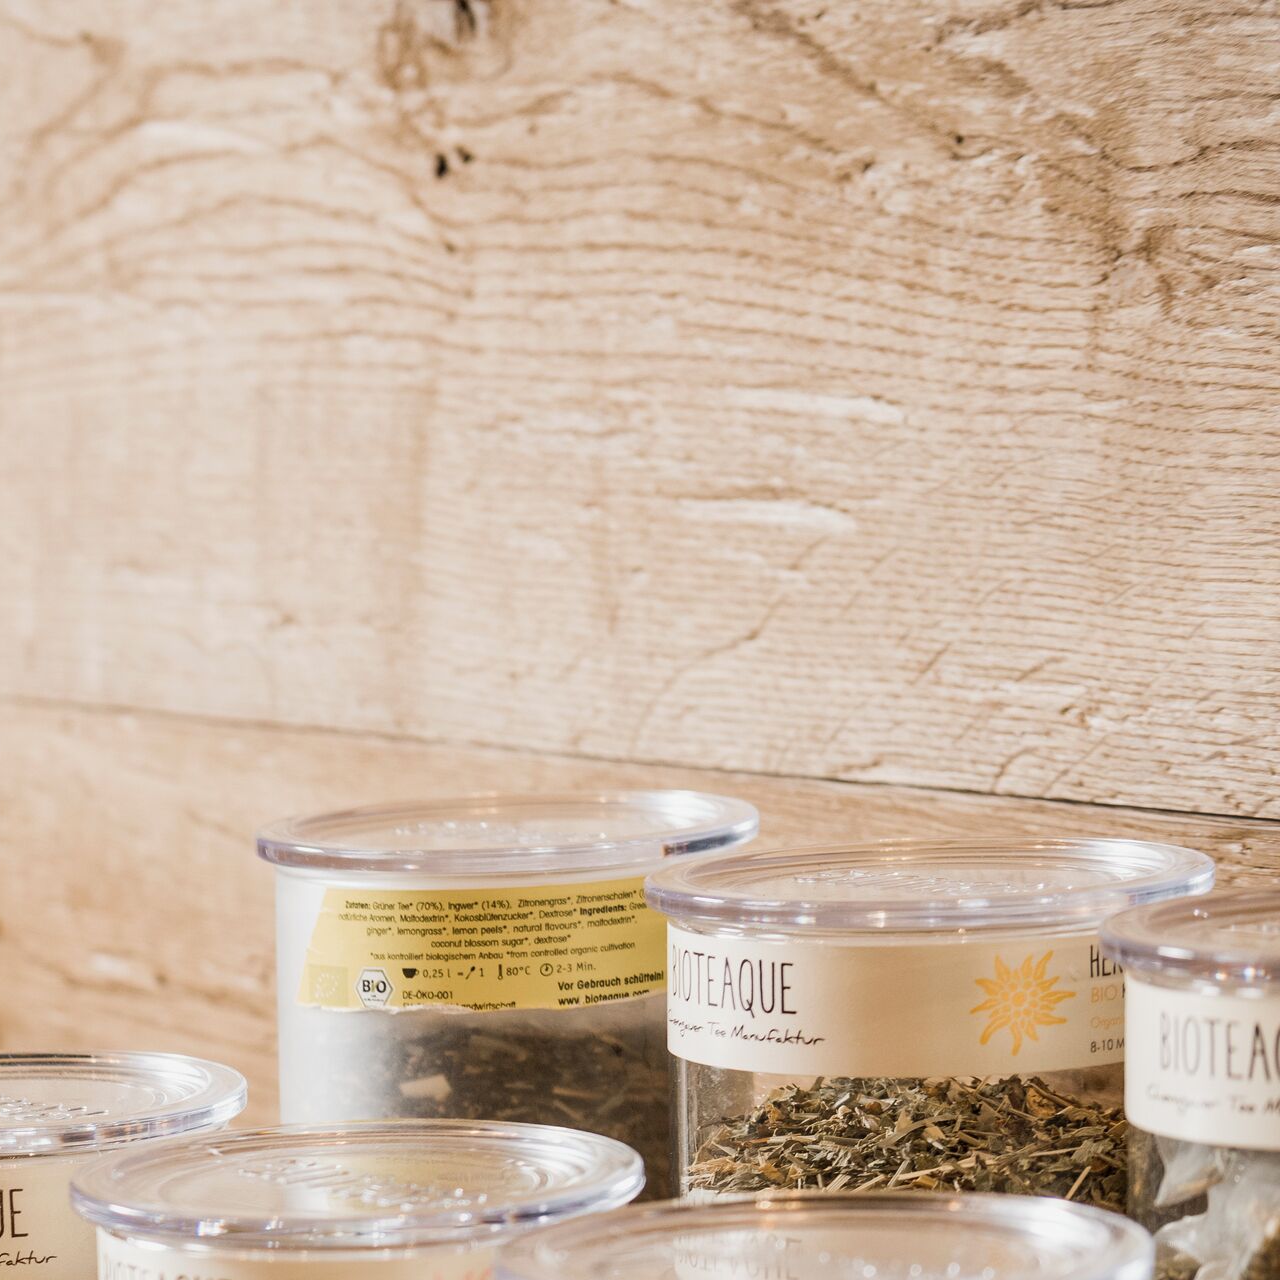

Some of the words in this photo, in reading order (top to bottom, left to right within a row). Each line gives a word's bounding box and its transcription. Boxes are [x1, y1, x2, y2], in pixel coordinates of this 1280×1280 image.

[580, 904, 627, 916] Ingredients:
[452, 927, 478, 935] lemon
[513, 924, 542, 933] natural
[388, 952, 424, 960] kontrolliert
[426, 951, 476, 962] biologischem
[479, 951, 503, 959] Anbau
[531, 949, 568, 957] controlled
[570, 947, 598, 956] organic
[600, 942, 636, 952] cultivation
[431, 940, 462, 948] coconut
[464, 939, 499, 947] blossom
[423, 969, 444, 979] 0,25
[506, 966, 531, 976] 80°C
[556, 964, 573, 974] 2-3
[576, 961, 597, 972] Min.
[558, 981, 574, 991] Vor
[577, 976, 621, 990] Gebrauch
[624, 971, 664, 985] schütteln!
[672, 944, 797, 1019] BIOTEAQUE
[402, 990, 453, 1000] DE-ÖKO-001
[1091, 985, 1119, 1003] BIO
[731, 1024, 827, 1046] Manufaktur
[1090, 1039, 1114, 1053] 8-10
[1160, 1011, 1280, 1081] BIOTEA
